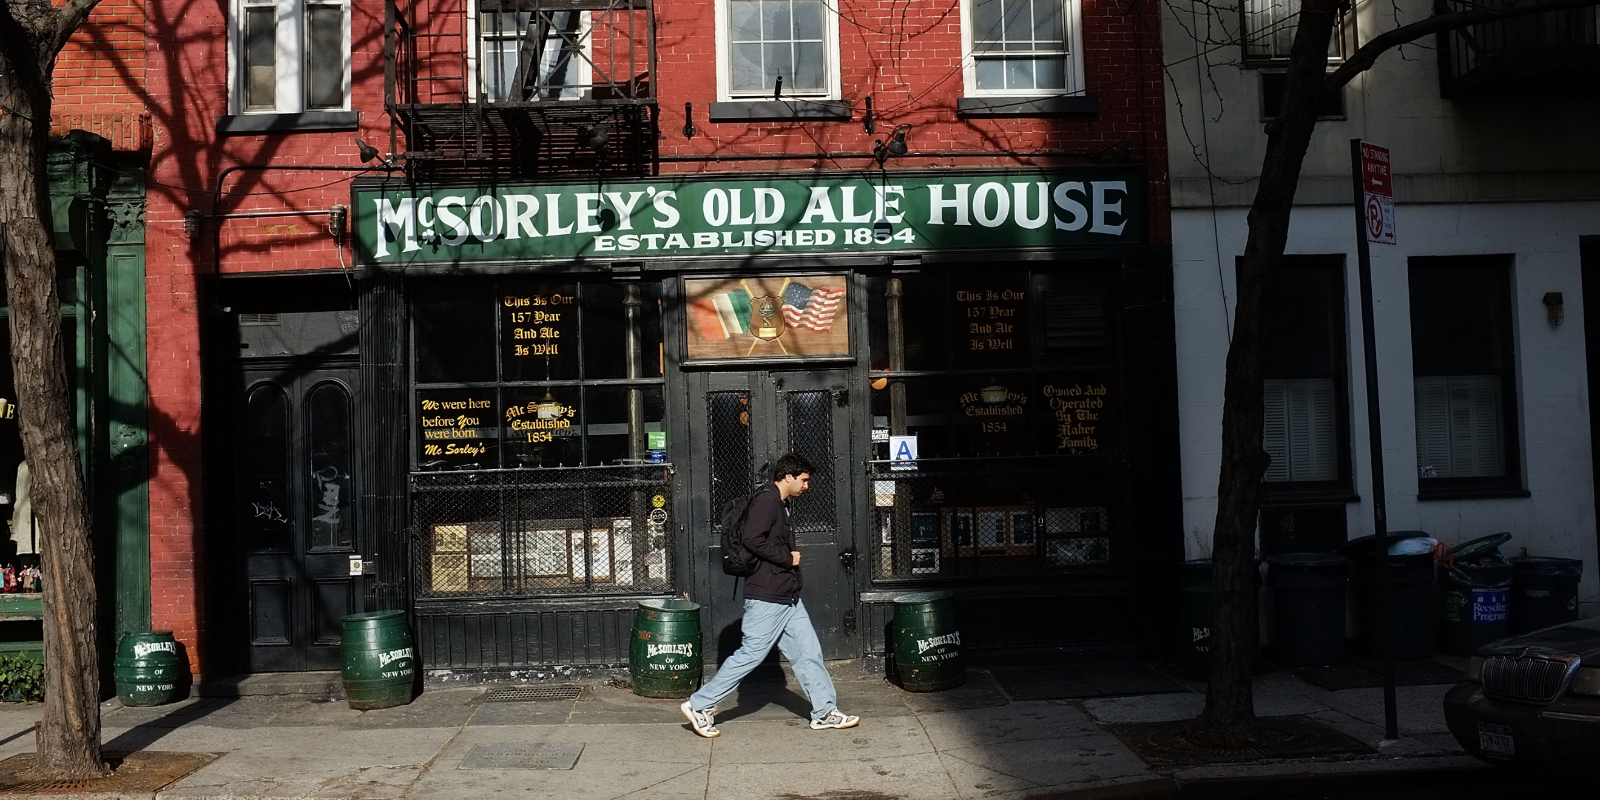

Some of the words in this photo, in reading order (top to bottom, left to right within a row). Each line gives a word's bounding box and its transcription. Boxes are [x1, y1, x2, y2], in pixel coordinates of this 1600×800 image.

[1363, 147, 1369, 158] NO
[1370, 149, 1389, 163] STANDING
[1367, 162, 1387, 176] ANYTIME
[373, 186, 680, 258] McSORLEY'S
[702, 187, 785, 227] OLD
[799, 185, 905, 224] ALE
[926, 181, 1128, 236] HOUSE
[594, 228, 836, 252] ESTABLISHED
[844, 227, 915, 245] 1854
[504, 295, 530, 308] This
[533, 294, 548, 306] Is
[550, 294, 574, 305] Our
[956, 290, 982, 303] This
[985, 289, 999, 301] Is
[1002, 289, 1025, 301] Our
[511, 312, 532, 323] 157
[533, 310, 561, 325] Year
[966, 307, 986, 318] 157
[988, 306, 1015, 319] Year
[514, 327, 537, 339] And
[540, 327, 560, 339] Ale
[969, 322, 992, 334] And
[994, 322, 1014, 334] Ale
[514, 344, 530, 356] Is
[532, 344, 559, 356] Well
[970, 339, 985, 351] Is
[987, 338, 1014, 350] Well
[1043, 382, 1082, 397] Owned
[1084, 382, 1107, 397] And
[421, 400, 440, 411] We
[441, 401, 467, 410] were
[468, 398, 491, 409] here
[960, 391, 979, 408] Mc
[1049, 396, 1104, 413] Operated
[505, 405, 526, 422] Mc
[526, 401, 577, 418] Sorley's
[965, 404, 1023, 418] Established
[1055, 409, 1072, 425] By
[1075, 409, 1100, 421] The
[422, 415, 455, 428] before
[456, 414, 480, 430] You
[511, 418, 571, 431] Established
[982, 422, 1008, 433] 1854
[424, 430, 450, 439] were
[451, 427, 478, 438] born.
[527, 431, 553, 443] 1854
[1057, 422, 1097, 438] Maher
[424, 444, 443, 456] Mc
[444, 442, 487, 457] Sorley's
[896, 440, 913, 461] A
[1057, 435, 1098, 452] Family
[1473, 601, 1507, 614] Recycling
[921, 655, 939, 663] NEW
[940, 650, 959, 661] YORK
[937, 647, 946, 655] OF
[649, 663, 667, 671] NEW
[669, 662, 690, 671] YORK
[381, 670, 399, 679] NEW
[136, 684, 155, 692] NEW
